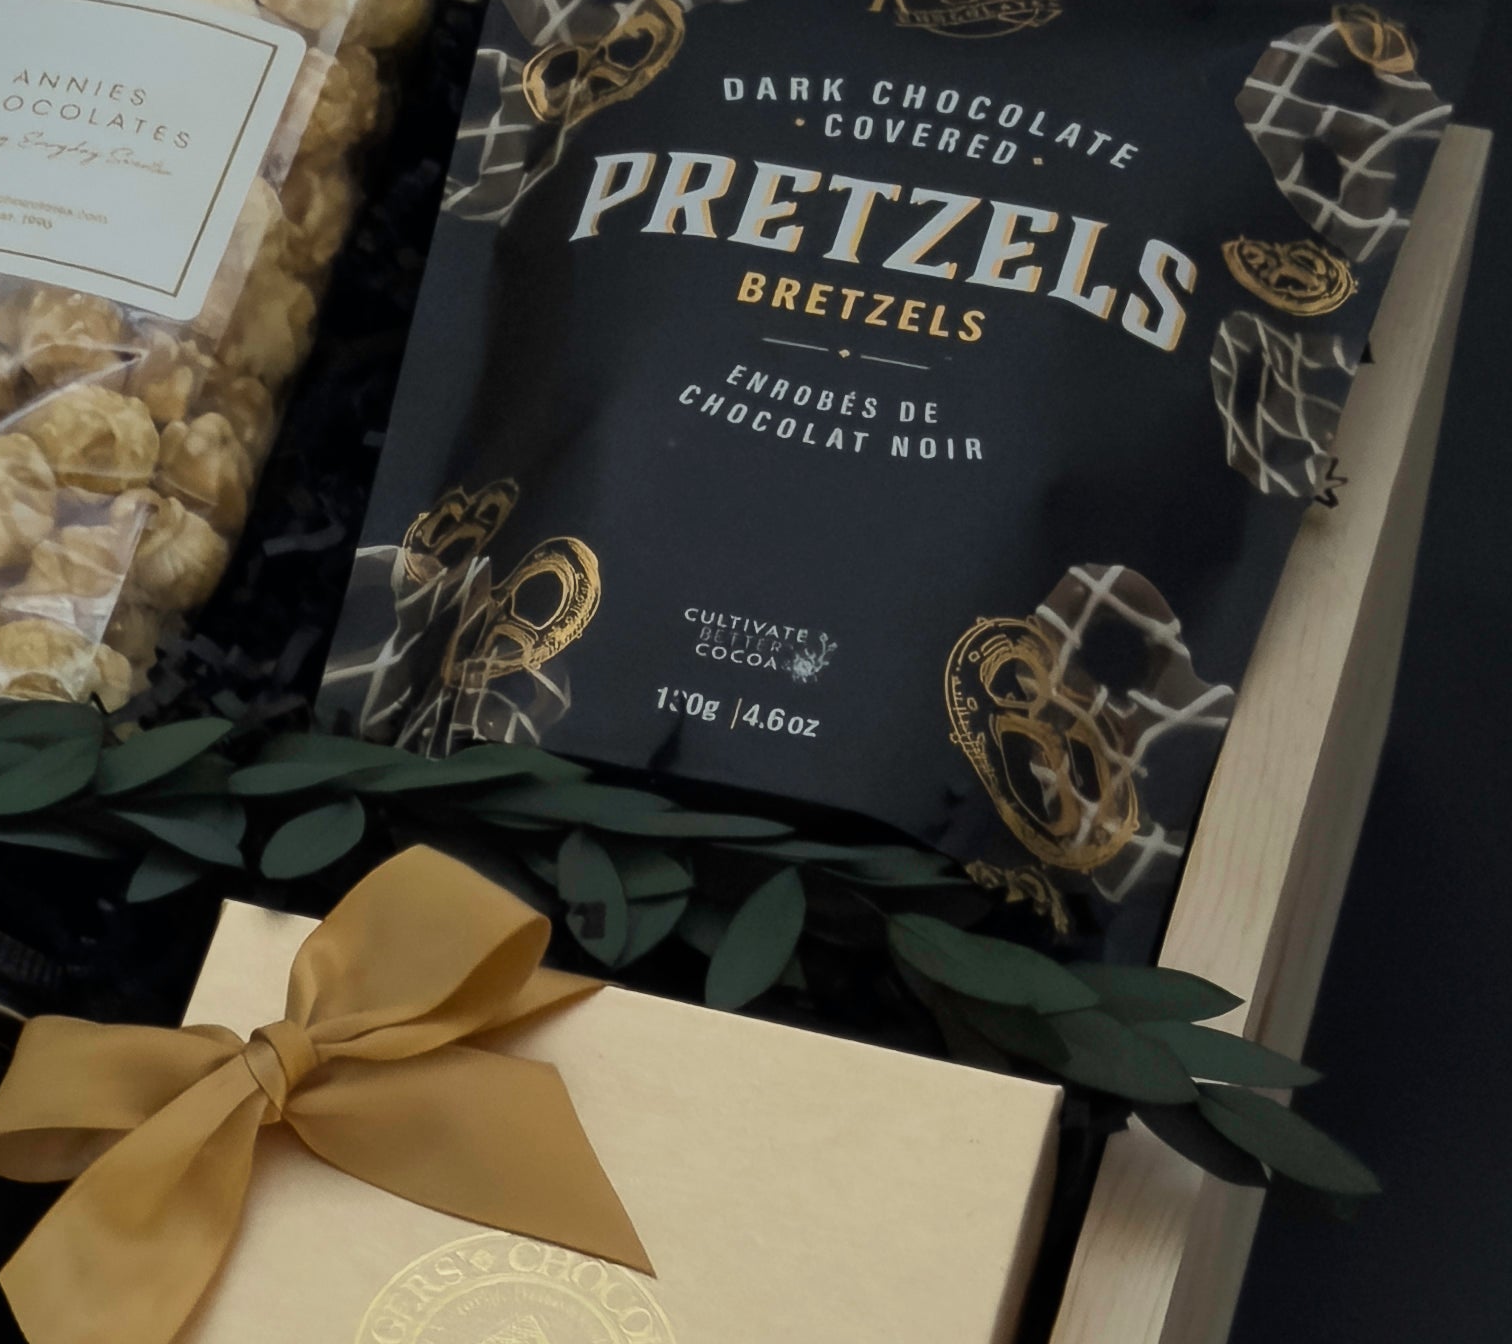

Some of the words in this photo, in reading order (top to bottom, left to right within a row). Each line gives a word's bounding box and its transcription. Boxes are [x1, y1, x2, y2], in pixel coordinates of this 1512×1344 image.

[12, 69, 147, 106] ANNIES
[723, 76, 845, 102] DARK
[872, 80, 1140, 169] CHOCOLATE
[824, 113, 1019, 166] COVERED
[568, 150, 1199, 353] PRETZELS
[736, 271, 987, 343] BRETZELS
[678, 384, 870, 453] CHOCOLAT
[890, 434, 983, 460] NOIR
[726, 364, 878, 420] ENROBÉS
[899, 401, 938, 425] DE
[684, 607, 809, 643] CULTIVATE
[699, 626, 783, 653] BETTER
[695, 643, 777, 671] COCOA
